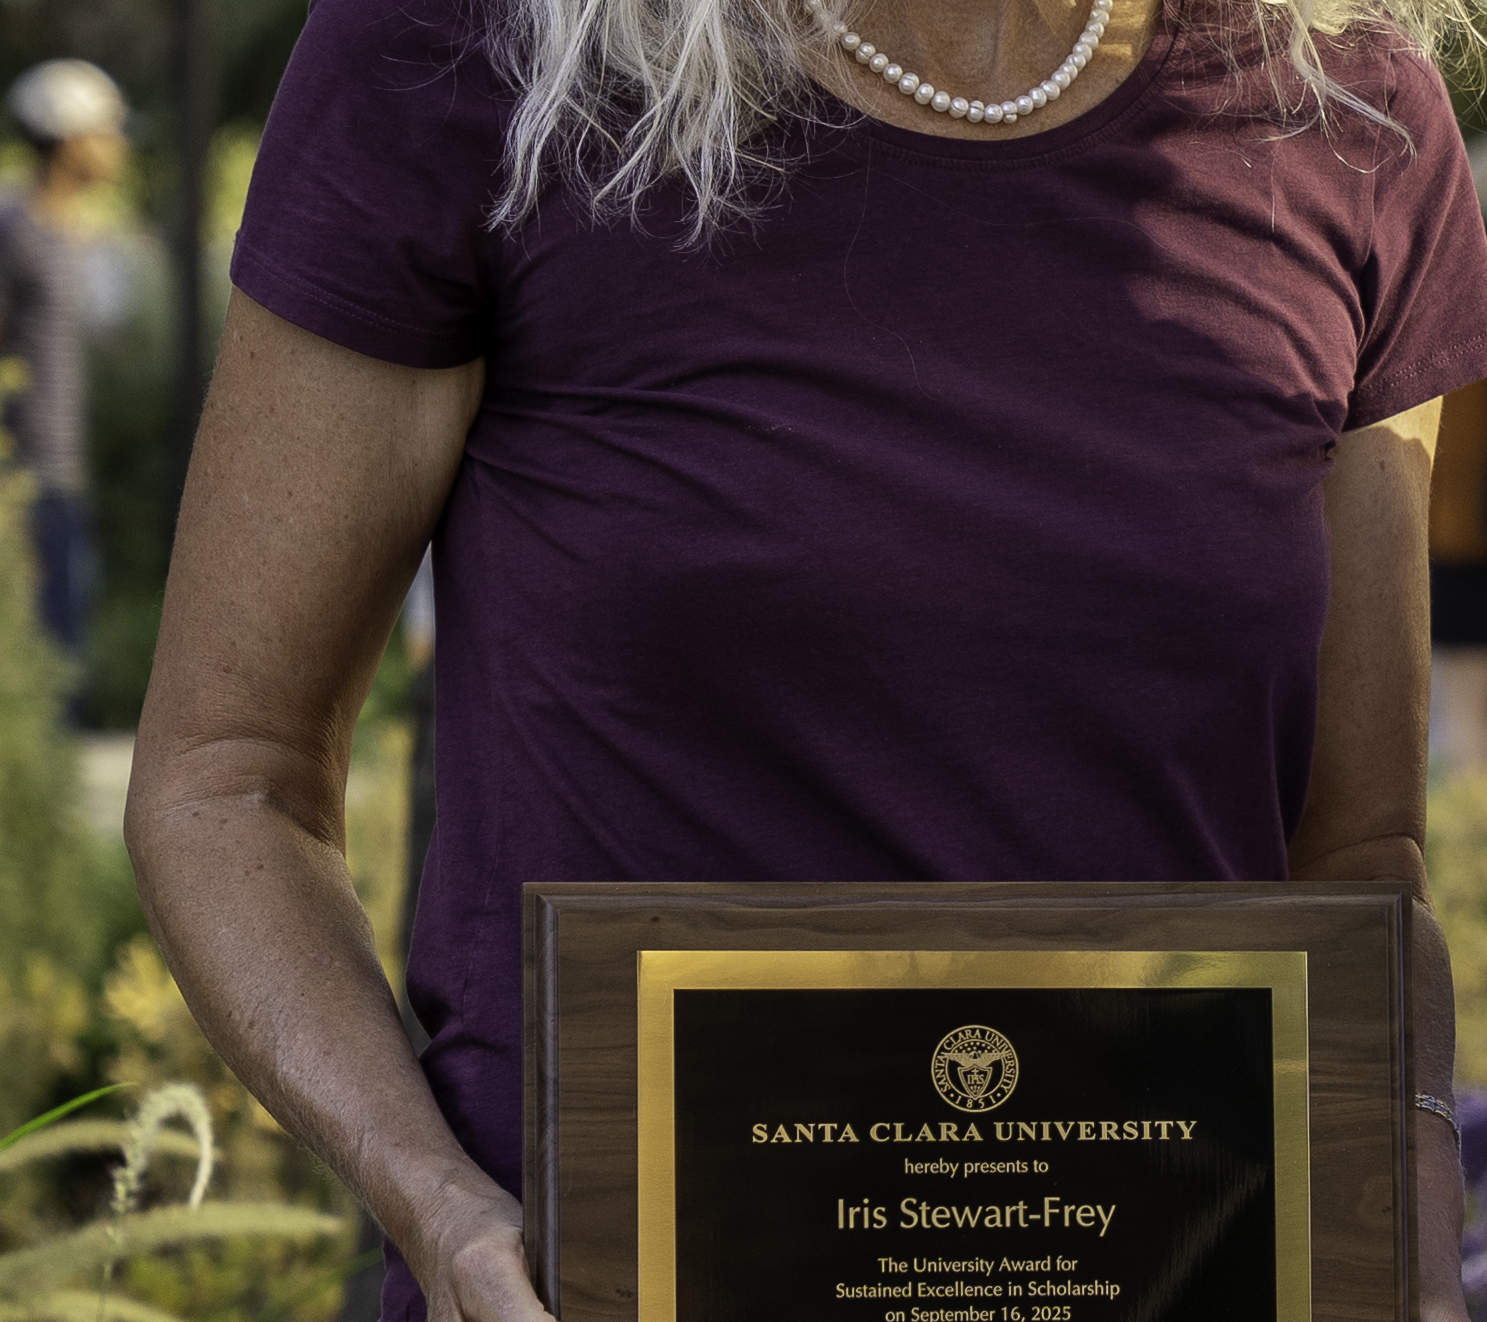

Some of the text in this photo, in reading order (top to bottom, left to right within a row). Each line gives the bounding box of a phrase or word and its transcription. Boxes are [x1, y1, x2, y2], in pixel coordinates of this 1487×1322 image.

[935, 1029, 1015, 1093] SANTA CLARA UNIVERSITY
[955, 1095, 996, 1109] 1851
[752, 1120, 1198, 1143] SANTA CLARA UNIVERSITY
[904, 1158, 1050, 1178] hereby presents to
[837, 1196, 1117, 1238] Iris Stewart-Frey
[877, 1254, 1079, 1278] The University Award for
[835, 1279, 1121, 1301] Sustained Excellence in Scholarship
[884, 1310, 906, 1322] on
[1030, 1305, 1072, 1322] 2025
